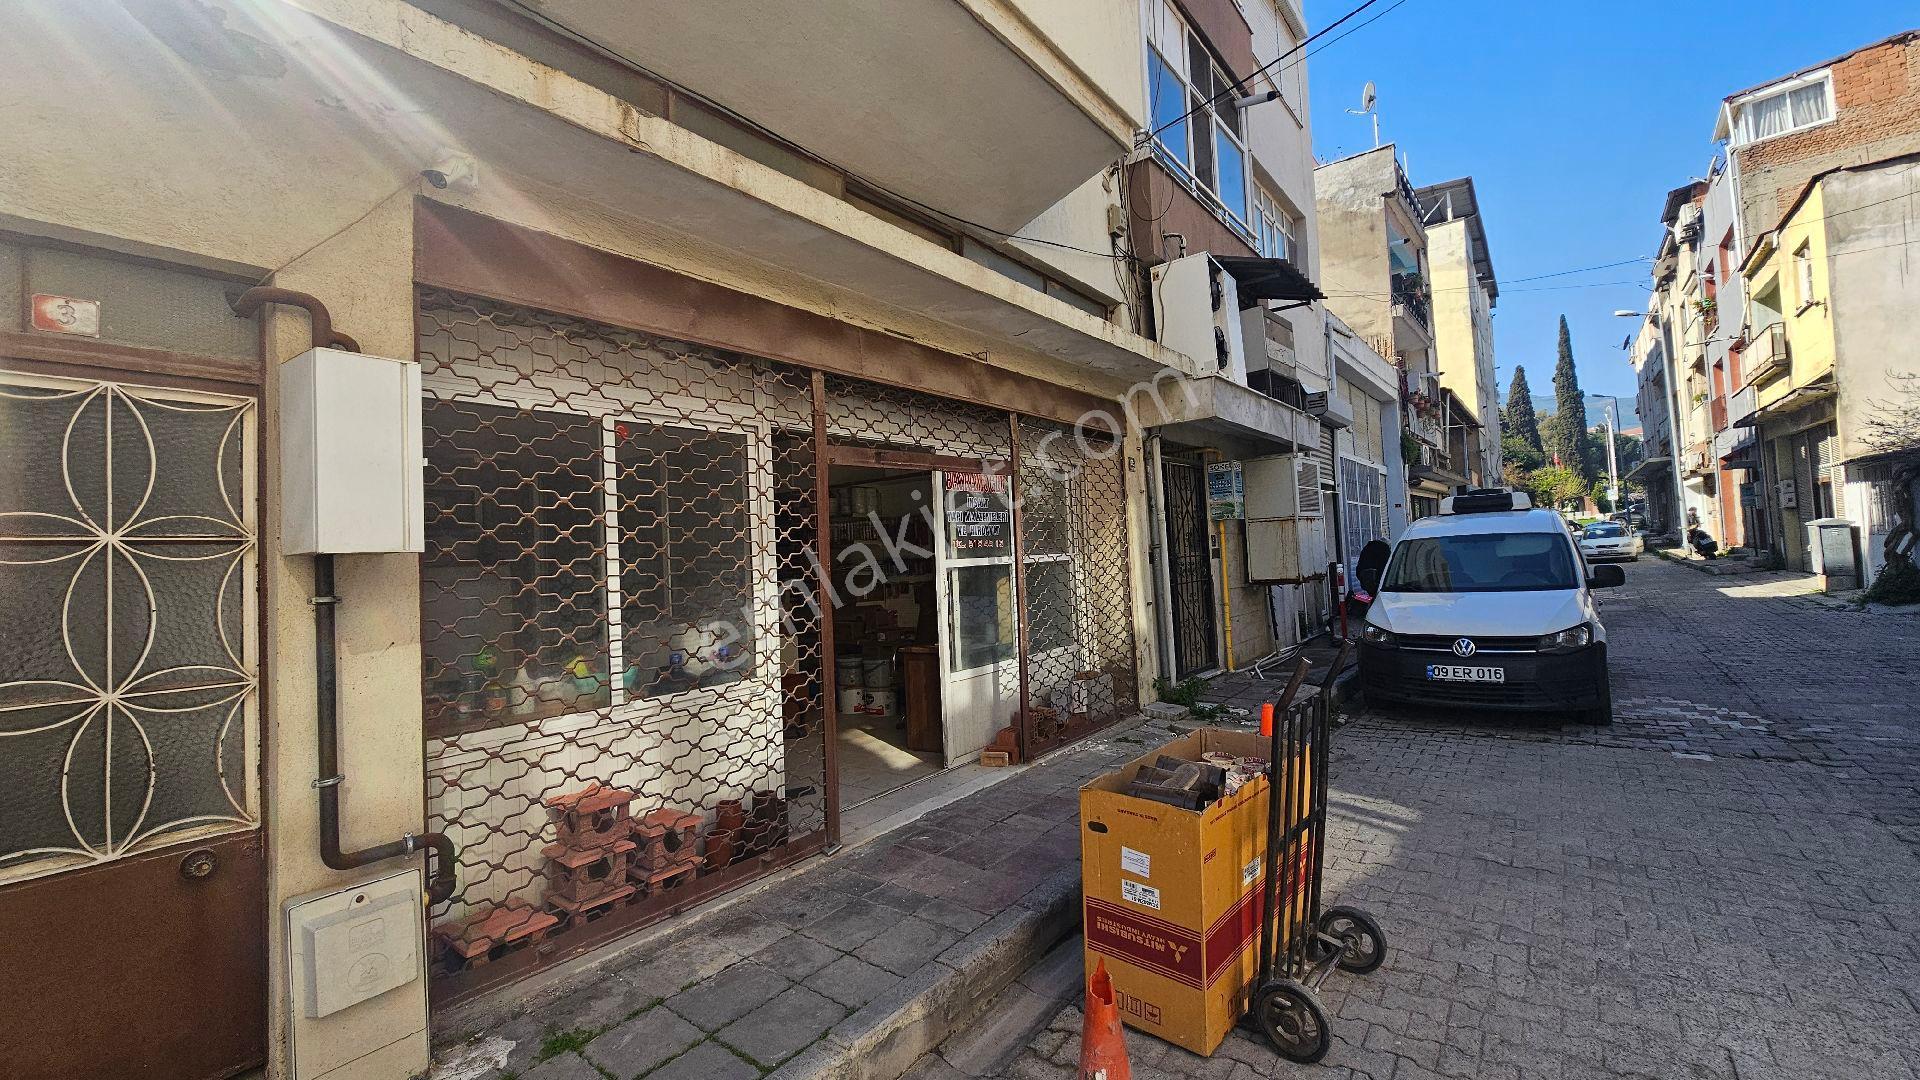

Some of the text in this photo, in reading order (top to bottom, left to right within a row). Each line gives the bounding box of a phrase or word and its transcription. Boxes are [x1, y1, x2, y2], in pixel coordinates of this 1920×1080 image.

[56, 304, 77, 326] 3
[1433, 666, 1502, 680] 09 ER 016
[1096, 921, 1165, 952] MITSUBISHI
